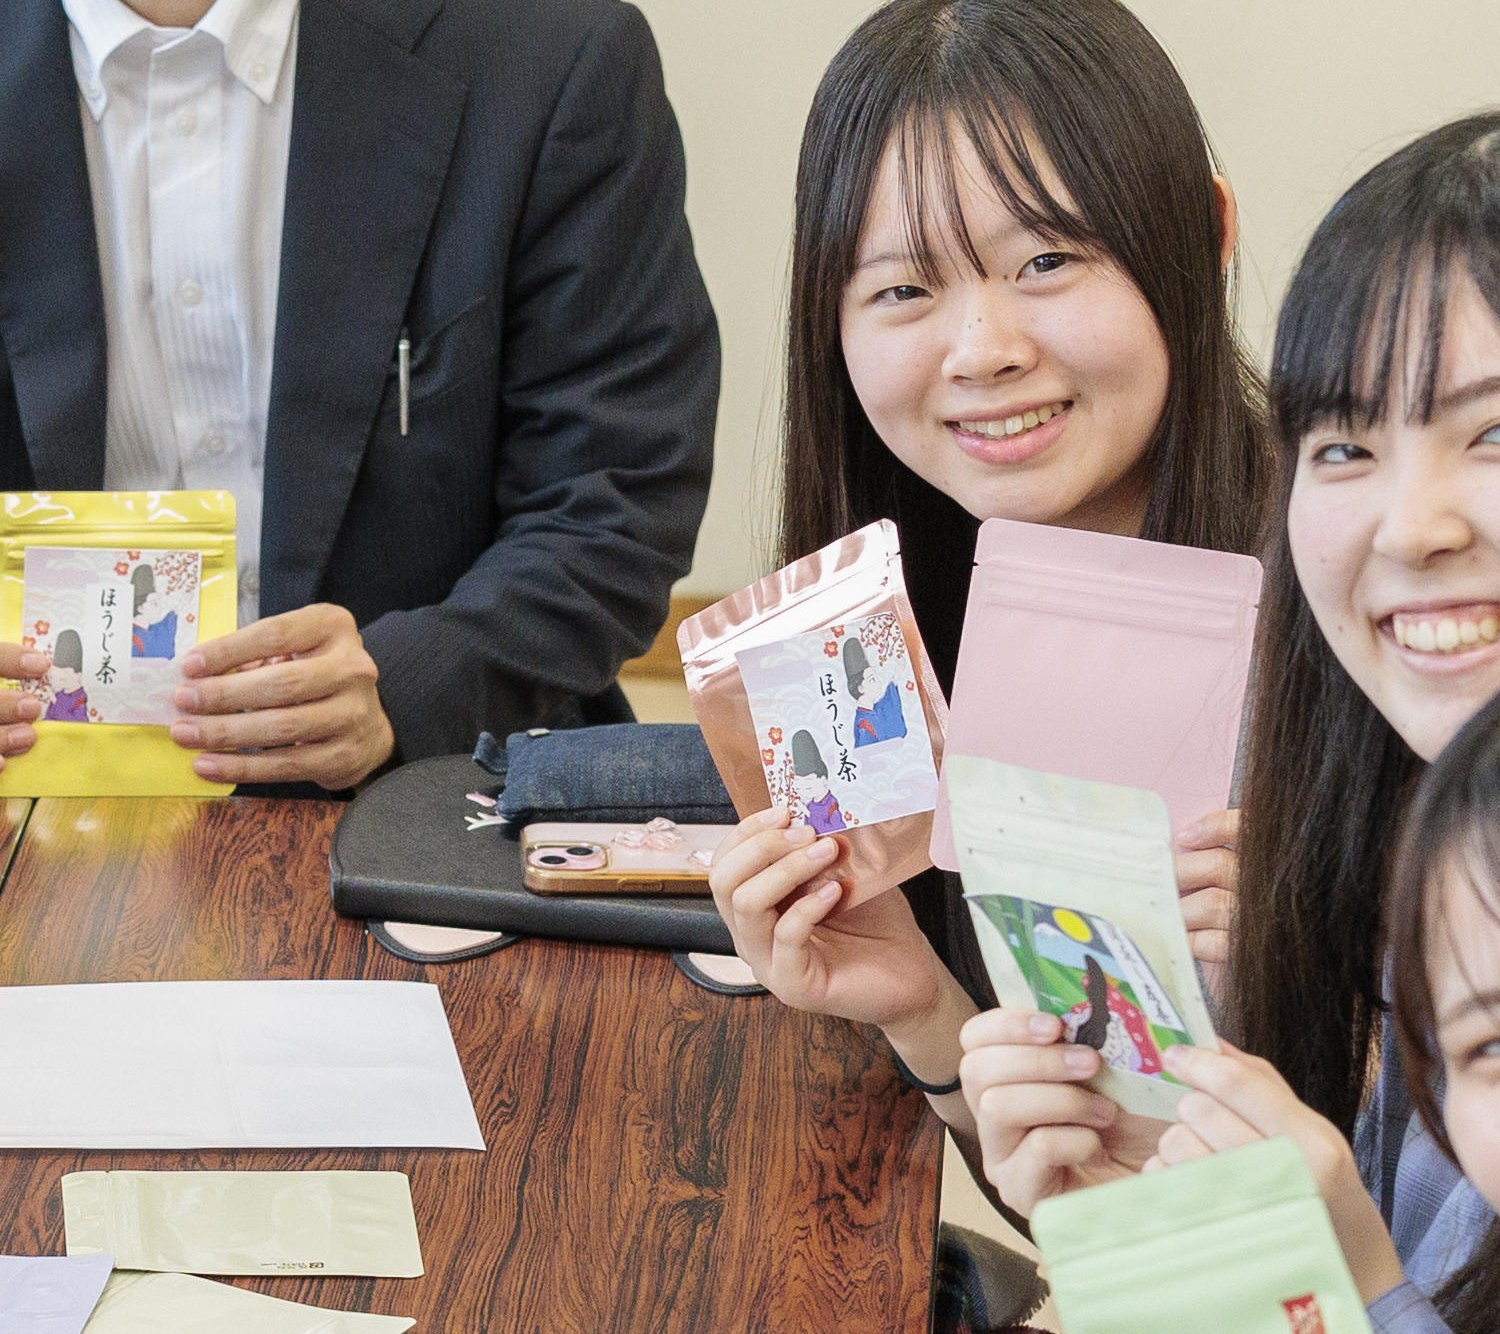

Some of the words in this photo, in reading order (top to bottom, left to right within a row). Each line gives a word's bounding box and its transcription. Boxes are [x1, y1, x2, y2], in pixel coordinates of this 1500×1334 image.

[95, 588, 118, 684] ほうじ茶
[819, 673, 857, 782] ほうじ茶
